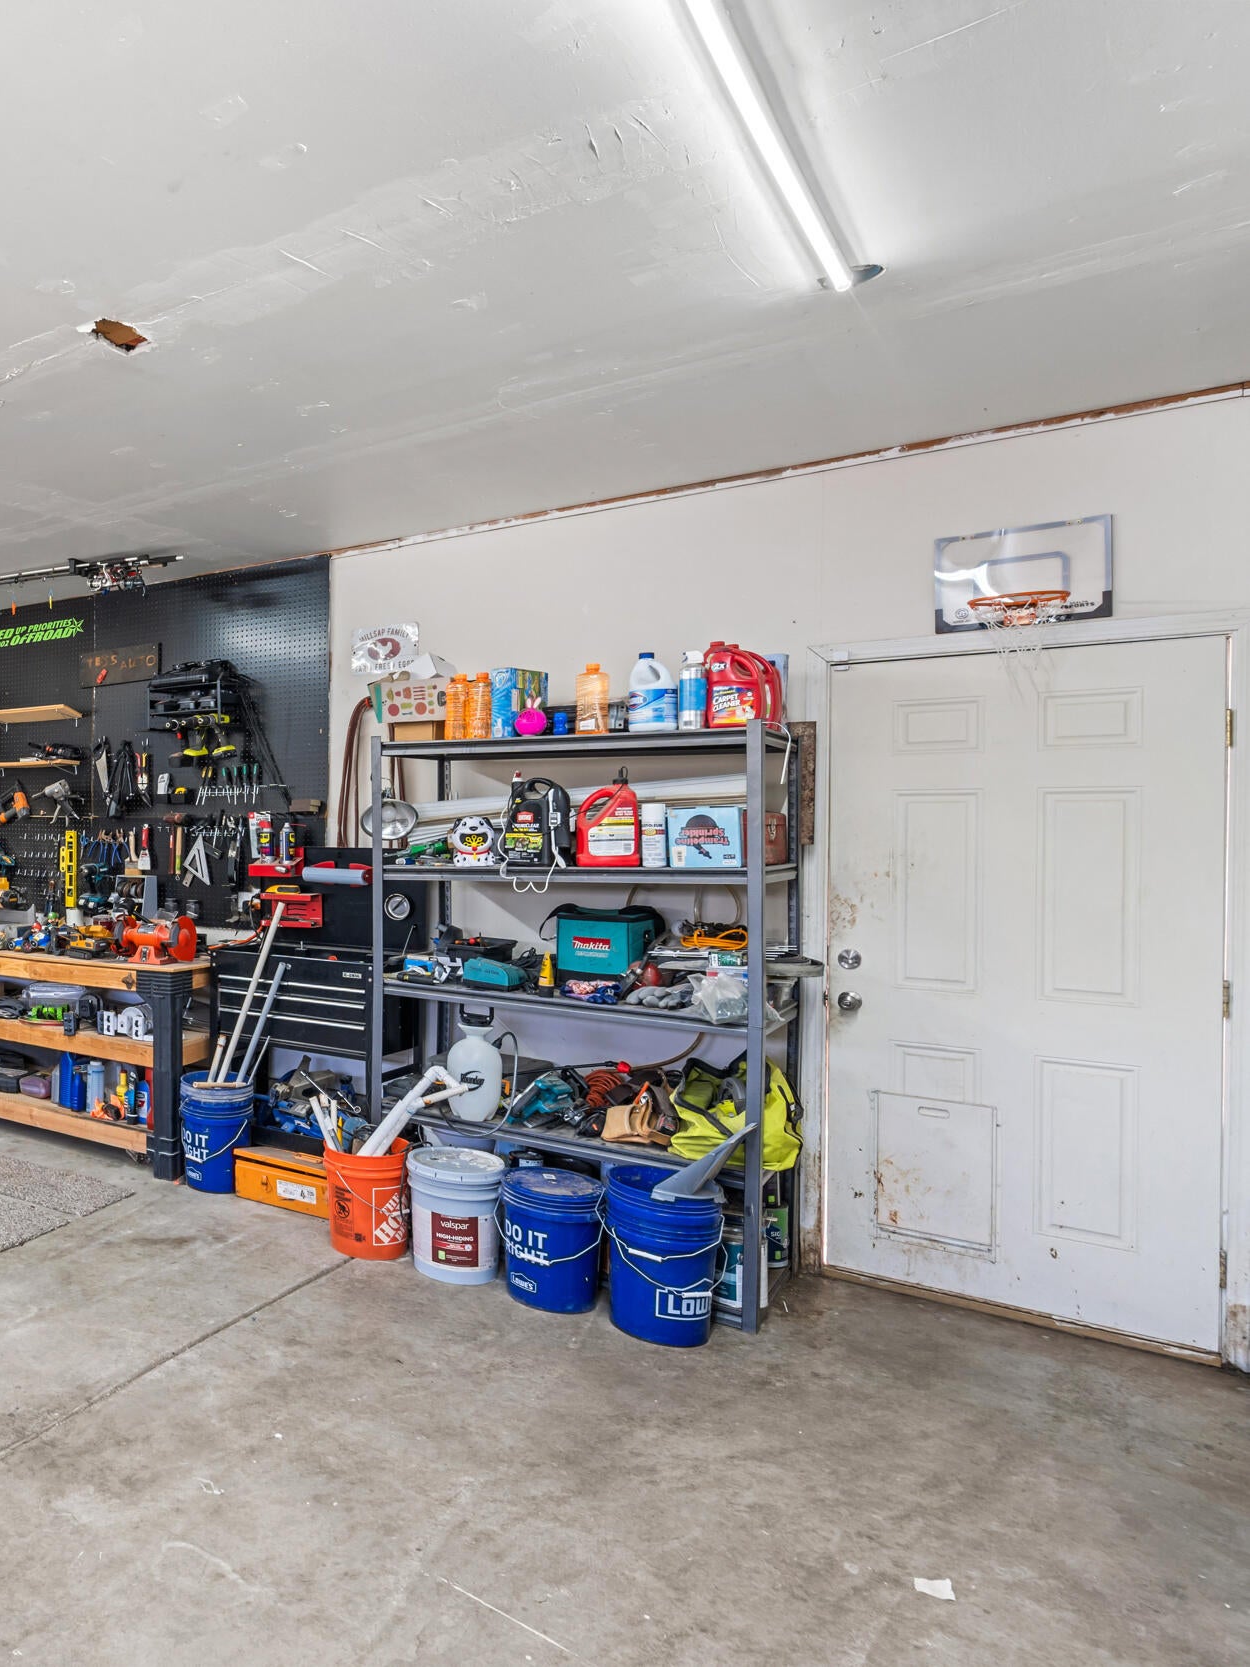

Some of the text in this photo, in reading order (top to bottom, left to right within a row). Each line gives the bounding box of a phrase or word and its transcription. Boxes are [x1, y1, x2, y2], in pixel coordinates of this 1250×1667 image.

[15, 625, 27, 635] UP
[28, 618, 73, 633] PRIORITIES
[387, 627, 410, 639] FAMILY
[10, 627, 72, 646] OFFROAD
[713, 693, 739, 705] CARPET
[713, 699, 741, 713] CLEANER
[195, 1133, 209, 1148] IT
[380, 1192, 400, 1216] THE
[440, 1220, 470, 1231] valspar
[436, 1232, 474, 1242] HIGH-HIDING
[505, 1218, 548, 1249] DO IT
[668, 1292, 711, 1316] LOW
